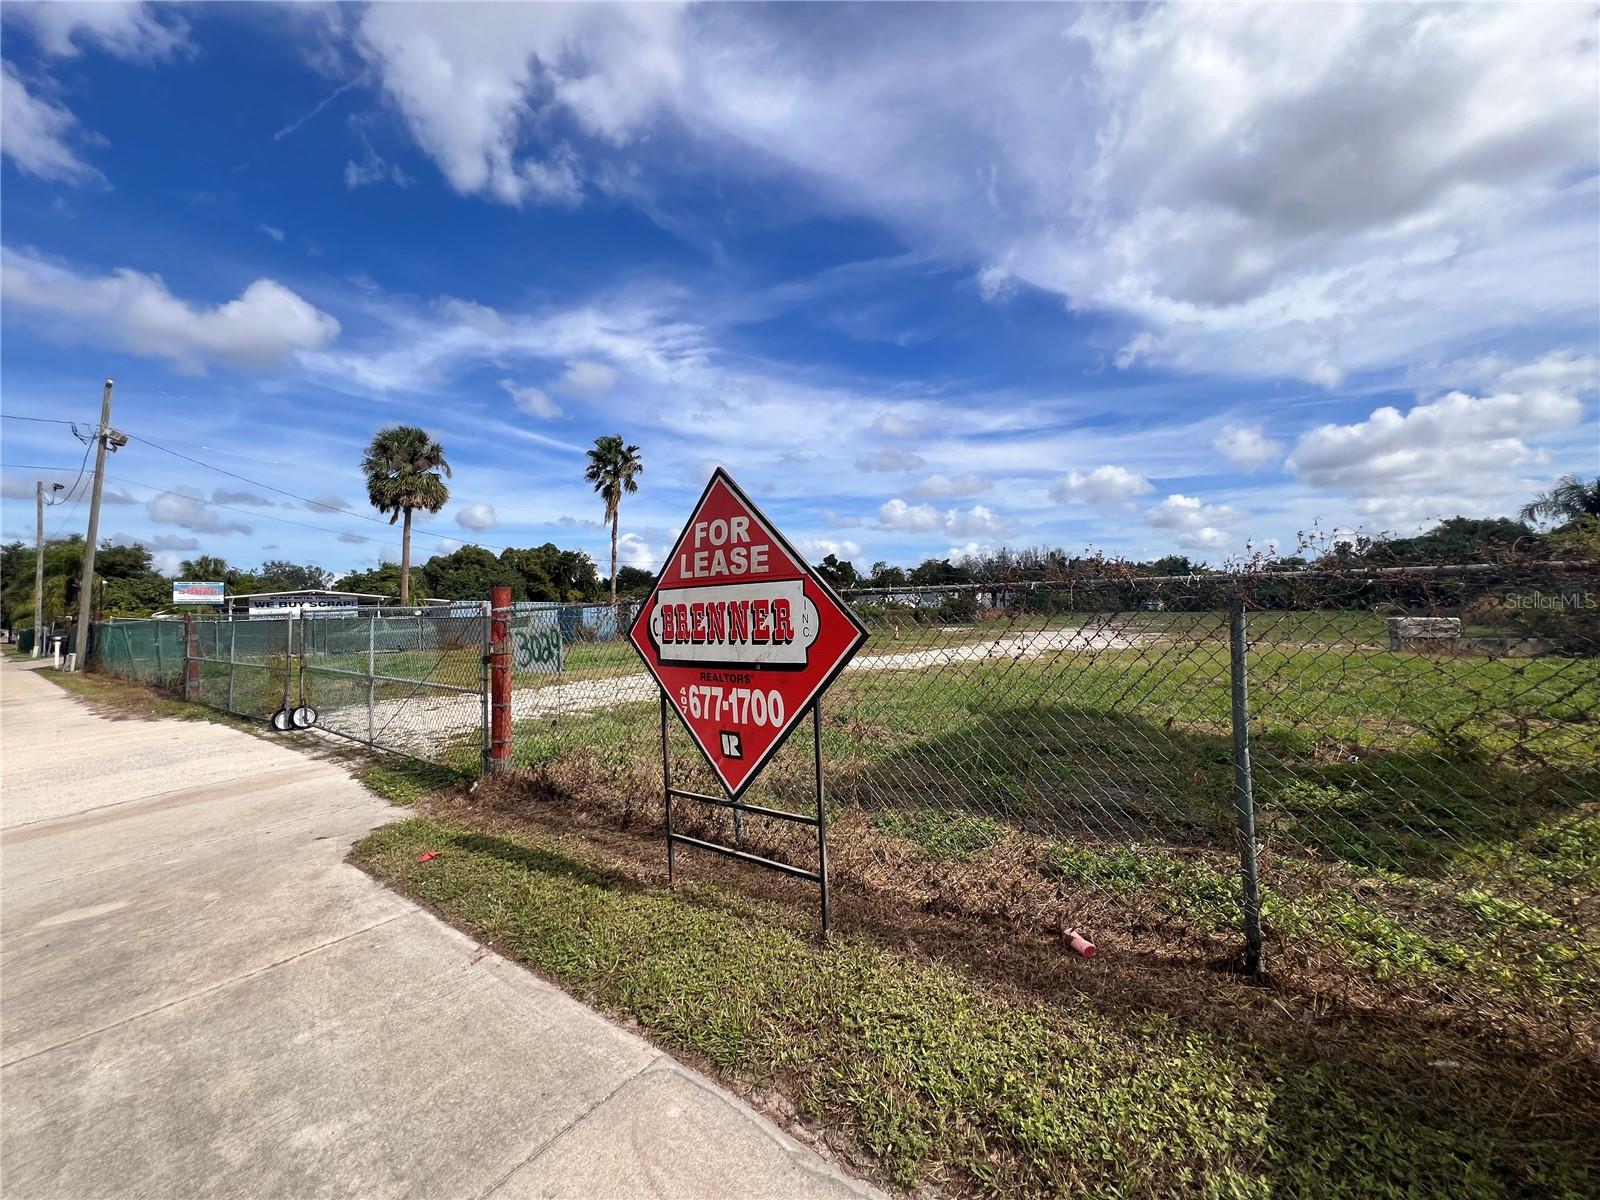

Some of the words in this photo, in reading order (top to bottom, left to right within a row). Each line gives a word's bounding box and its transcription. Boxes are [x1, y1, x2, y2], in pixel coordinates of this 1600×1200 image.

[694, 516, 750, 548] FOR
[680, 544, 769, 579] LEASE
[661, 598, 795, 645] BRENNER
[689, 684, 785, 728] 677-1700
